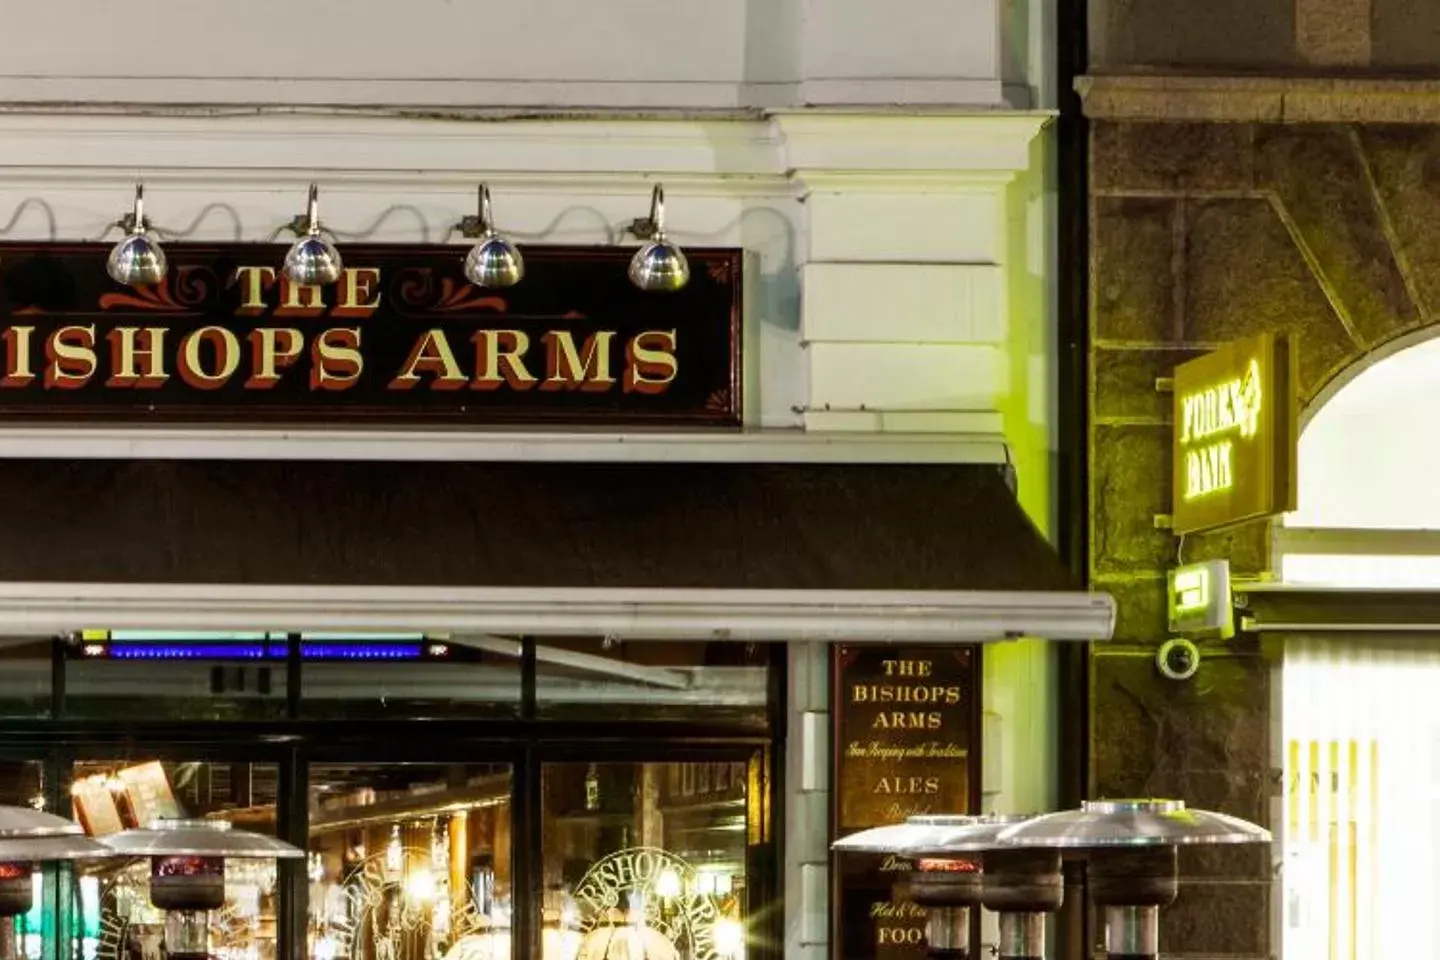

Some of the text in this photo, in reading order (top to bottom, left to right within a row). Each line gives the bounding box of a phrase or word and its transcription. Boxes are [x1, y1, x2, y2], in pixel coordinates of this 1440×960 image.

[232, 266, 382, 312] THE
[394, 327, 678, 385] ARMS
[882, 660, 933, 676] THE
[852, 684, 961, 704] BISHOPS
[872, 711, 943, 729] ARMS
[873, 777, 940, 794] ALES
[879, 926, 923, 944] FOO
